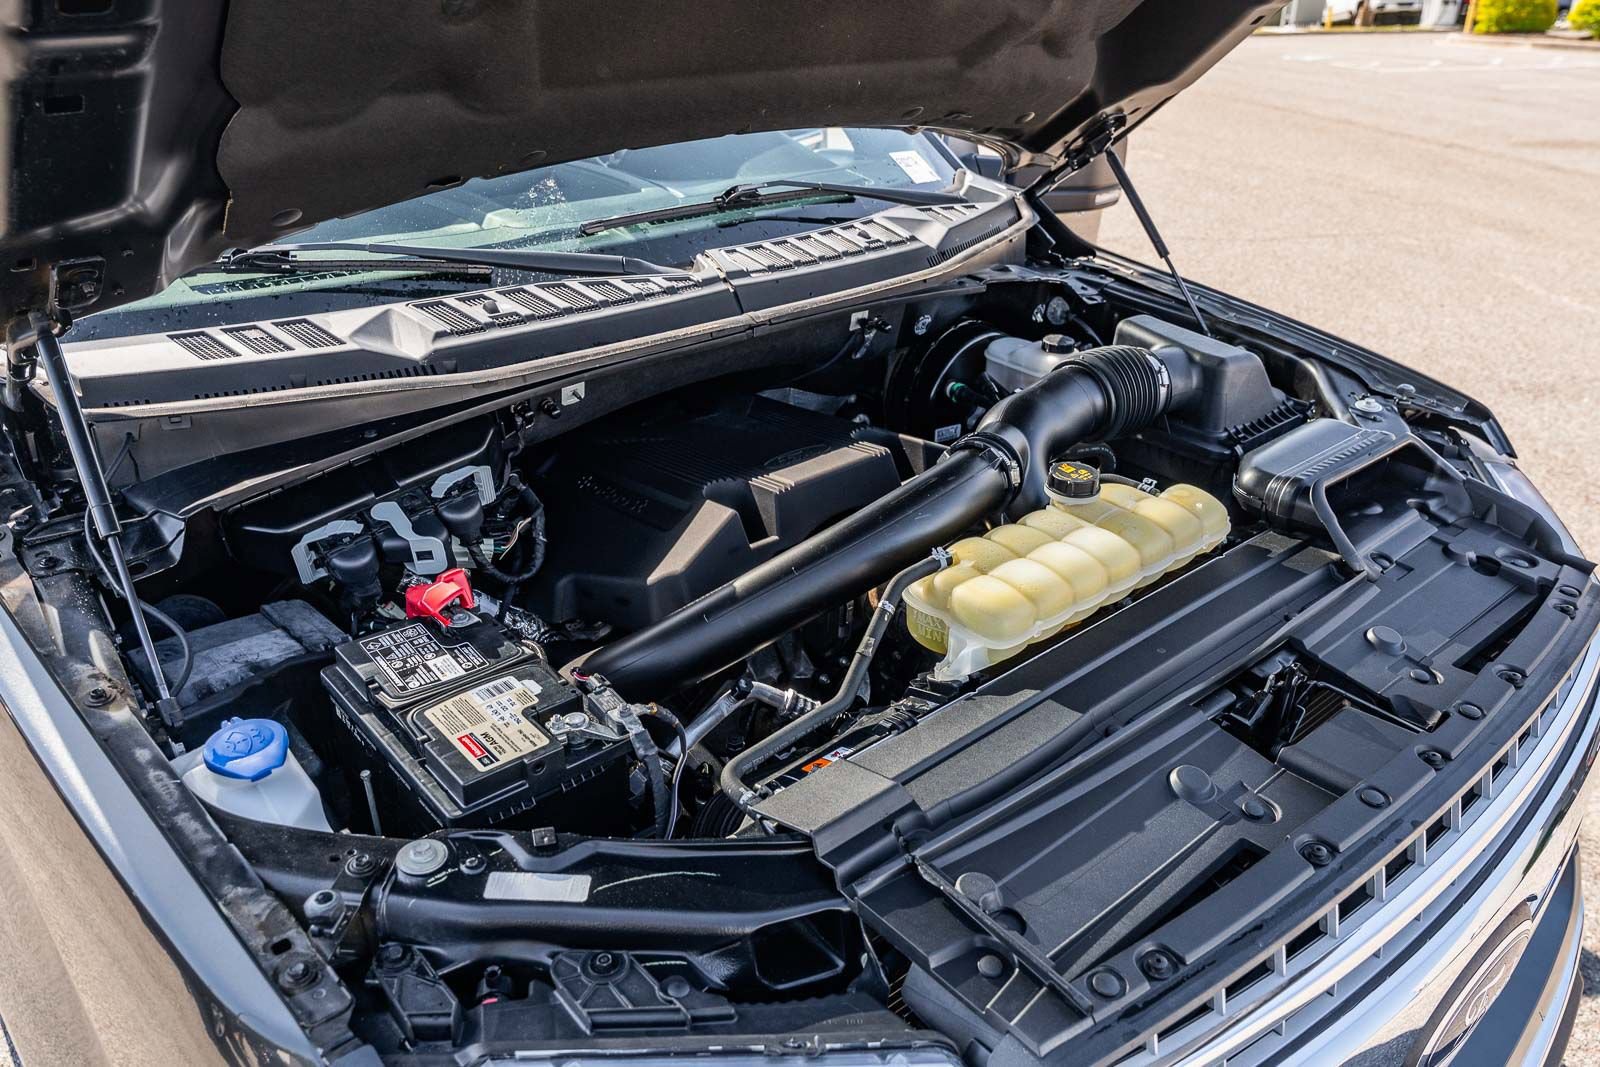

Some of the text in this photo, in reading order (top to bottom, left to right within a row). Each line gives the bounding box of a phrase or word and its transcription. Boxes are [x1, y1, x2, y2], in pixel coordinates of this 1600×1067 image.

[916, 613, 942, 629] MAX
[918, 624, 942, 642] MIN
[459, 735, 484, 757] Motorcraft
[479, 730, 498, 746] AGM
